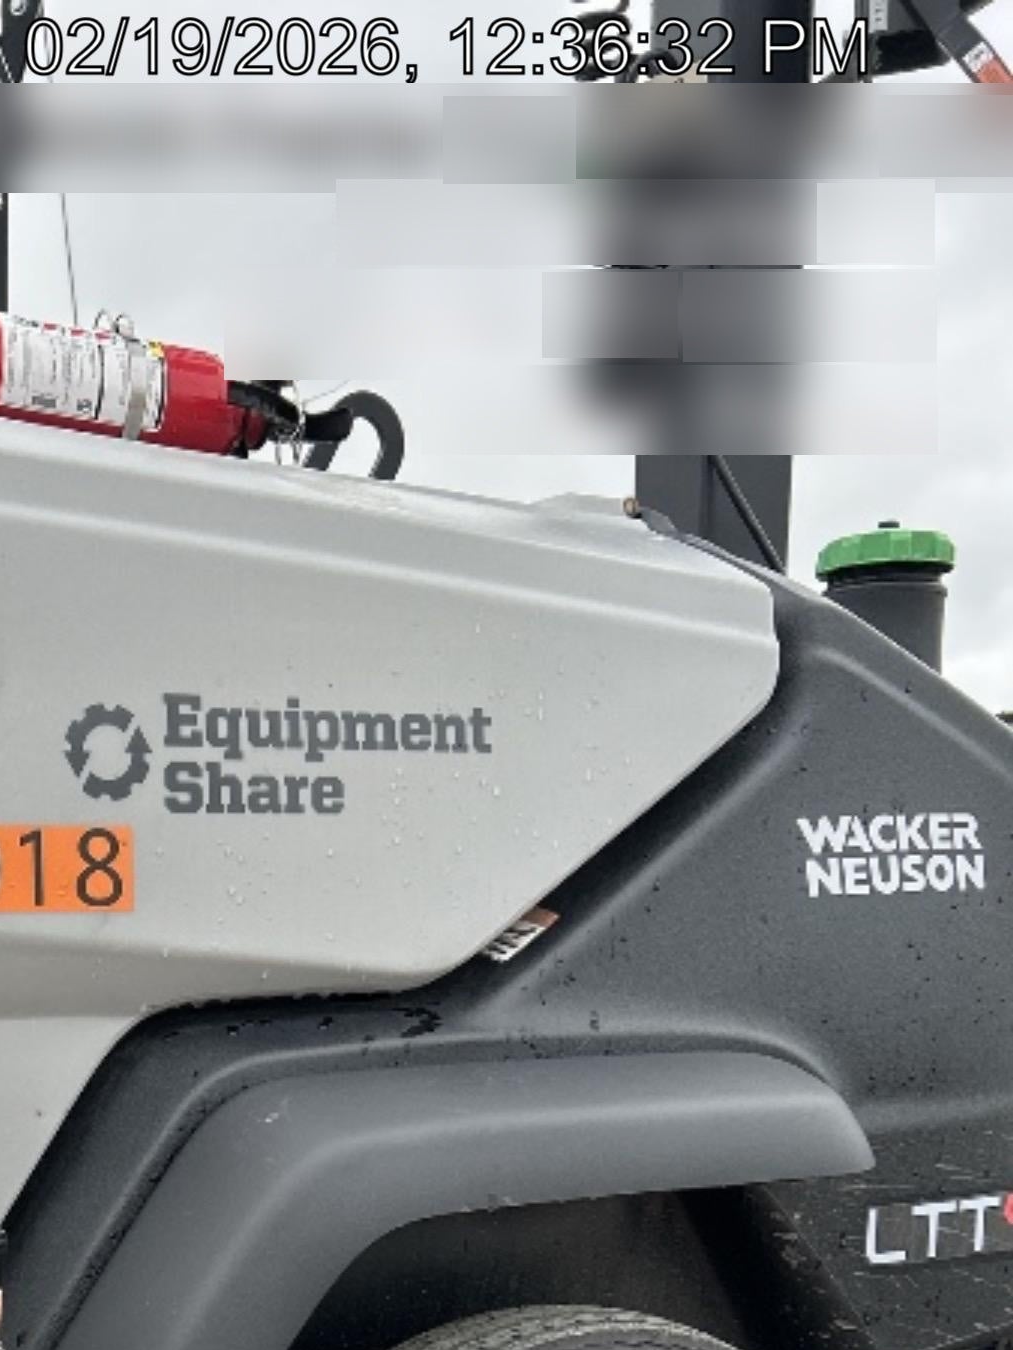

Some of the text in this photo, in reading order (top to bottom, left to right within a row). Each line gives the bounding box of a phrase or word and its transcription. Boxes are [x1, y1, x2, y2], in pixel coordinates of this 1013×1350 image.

[163, 693, 492, 762] Equipment
[163, 761, 345, 814] Share
[797, 812, 982, 854] WACKER
[806, 854, 985, 899] NEUSON
